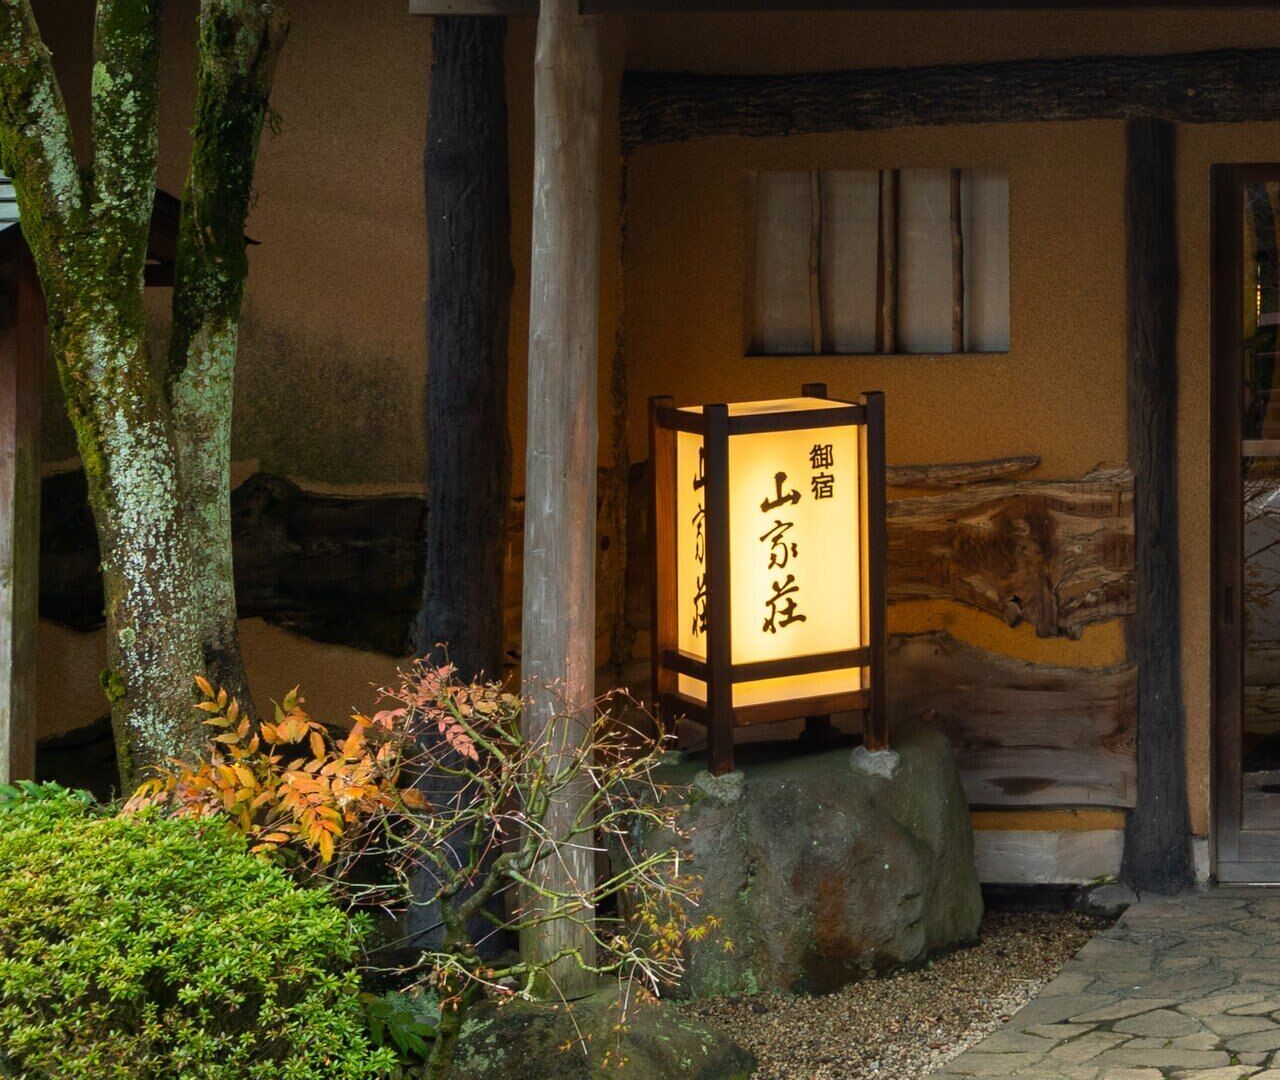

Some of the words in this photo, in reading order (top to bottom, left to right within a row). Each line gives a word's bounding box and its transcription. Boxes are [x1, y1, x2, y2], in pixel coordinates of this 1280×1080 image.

[809, 444, 835, 500] 御宿
[759, 471, 807, 634] 山家荘
